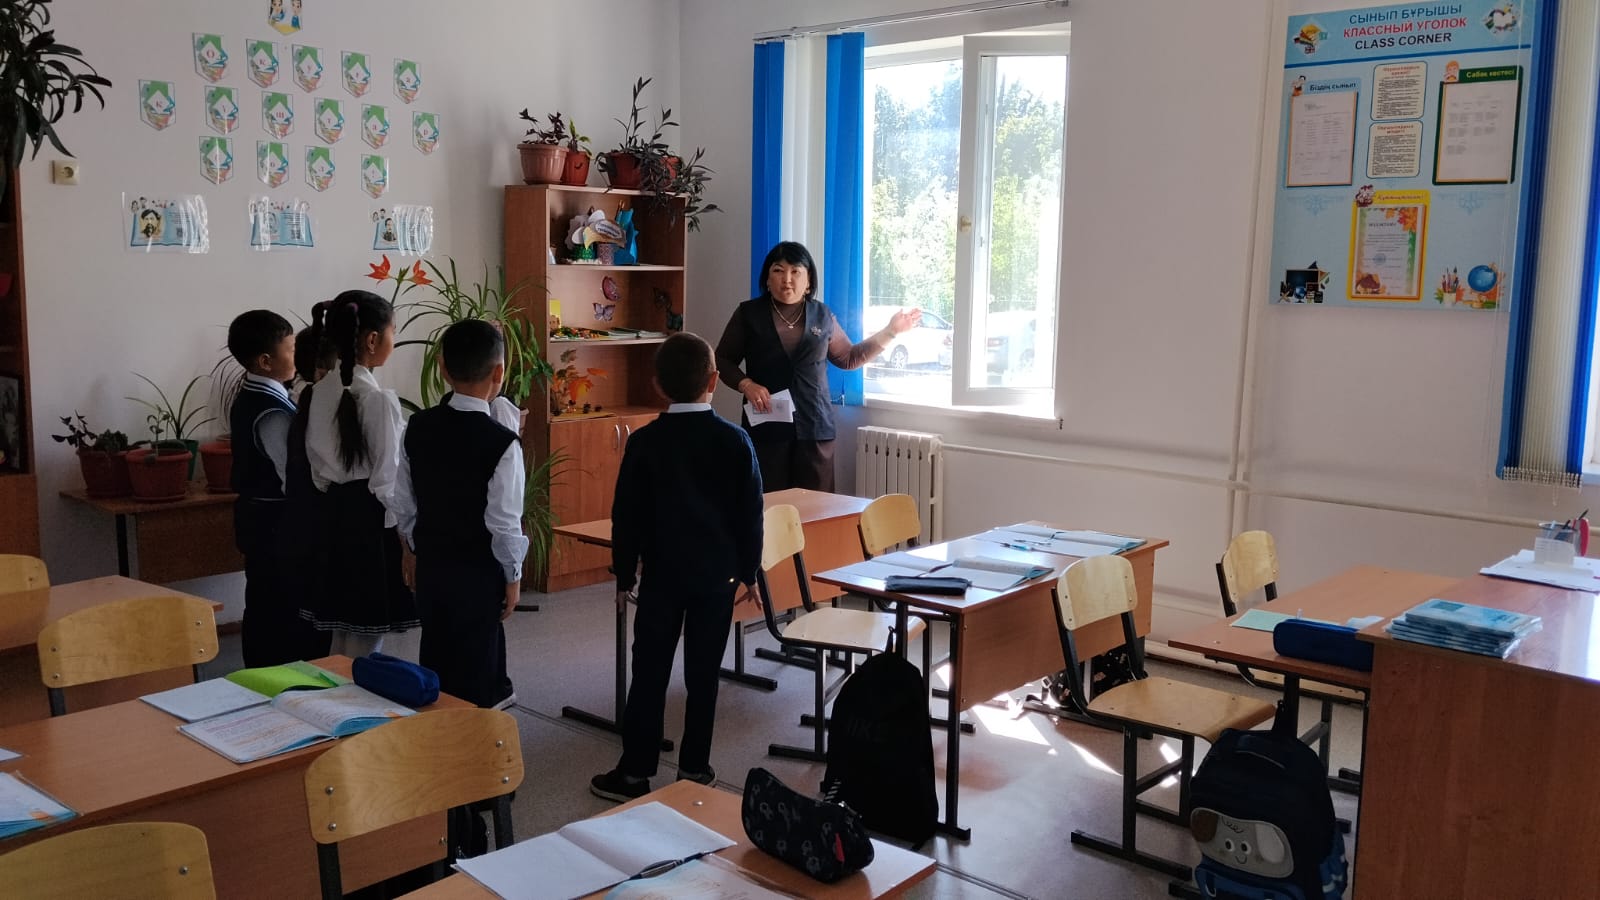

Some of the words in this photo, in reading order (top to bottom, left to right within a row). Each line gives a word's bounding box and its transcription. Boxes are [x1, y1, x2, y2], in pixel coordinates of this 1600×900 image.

[1349, 10, 1398, 25] СЫНЫП
[1401, 4, 1462, 19] БҰРЫШЫ
[1343, 20, 1413, 38] КЛАССНЫЙ
[1417, 16, 1468, 31] УГОЛОК
[1355, 37, 1395, 50] CLASS
[1398, 32, 1452, 46] CORNER
